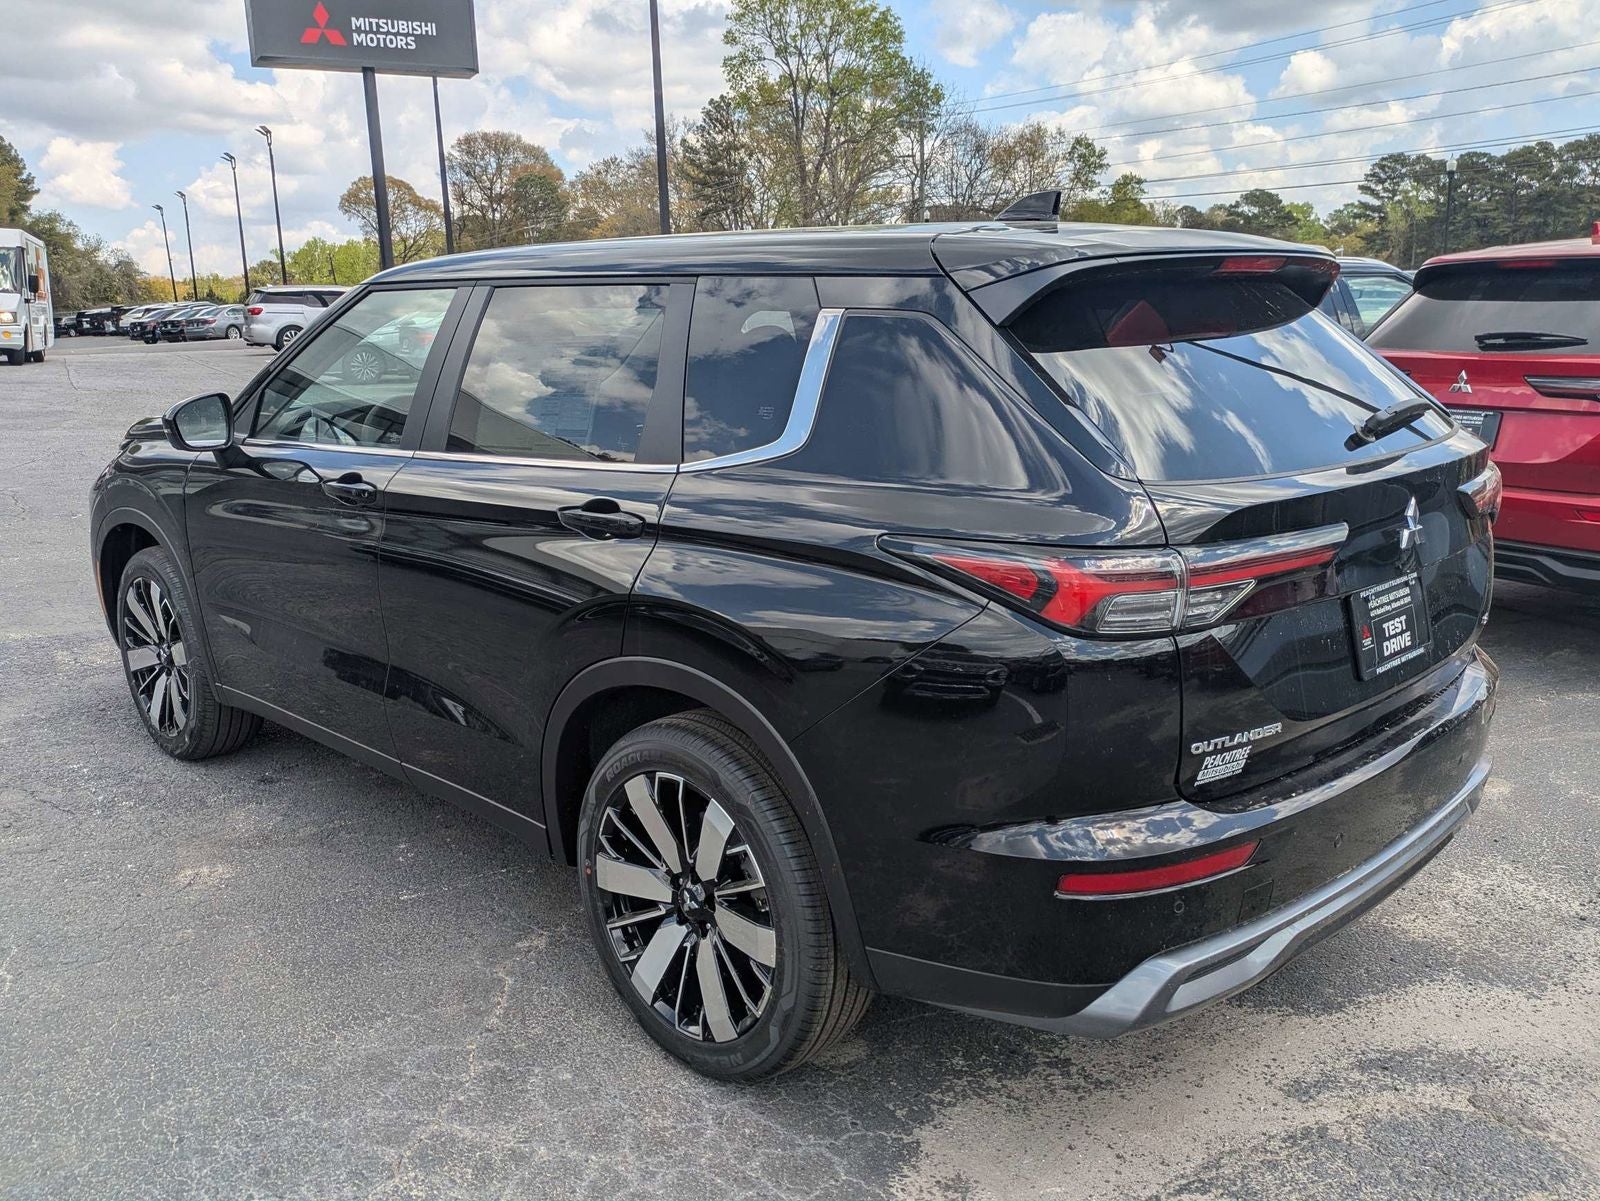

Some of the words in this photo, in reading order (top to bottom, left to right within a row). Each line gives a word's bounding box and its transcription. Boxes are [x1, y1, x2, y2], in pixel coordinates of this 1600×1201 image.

[351, 17, 437, 36] MITSUBISHI
[352, 32, 416, 49] MOTORS
[1382, 615, 1407, 637] TEST
[1383, 631, 1412, 657] DRIVE
[1190, 722, 1283, 755] OUTLANDER
[1201, 745, 1252, 770] PEACHTREE
